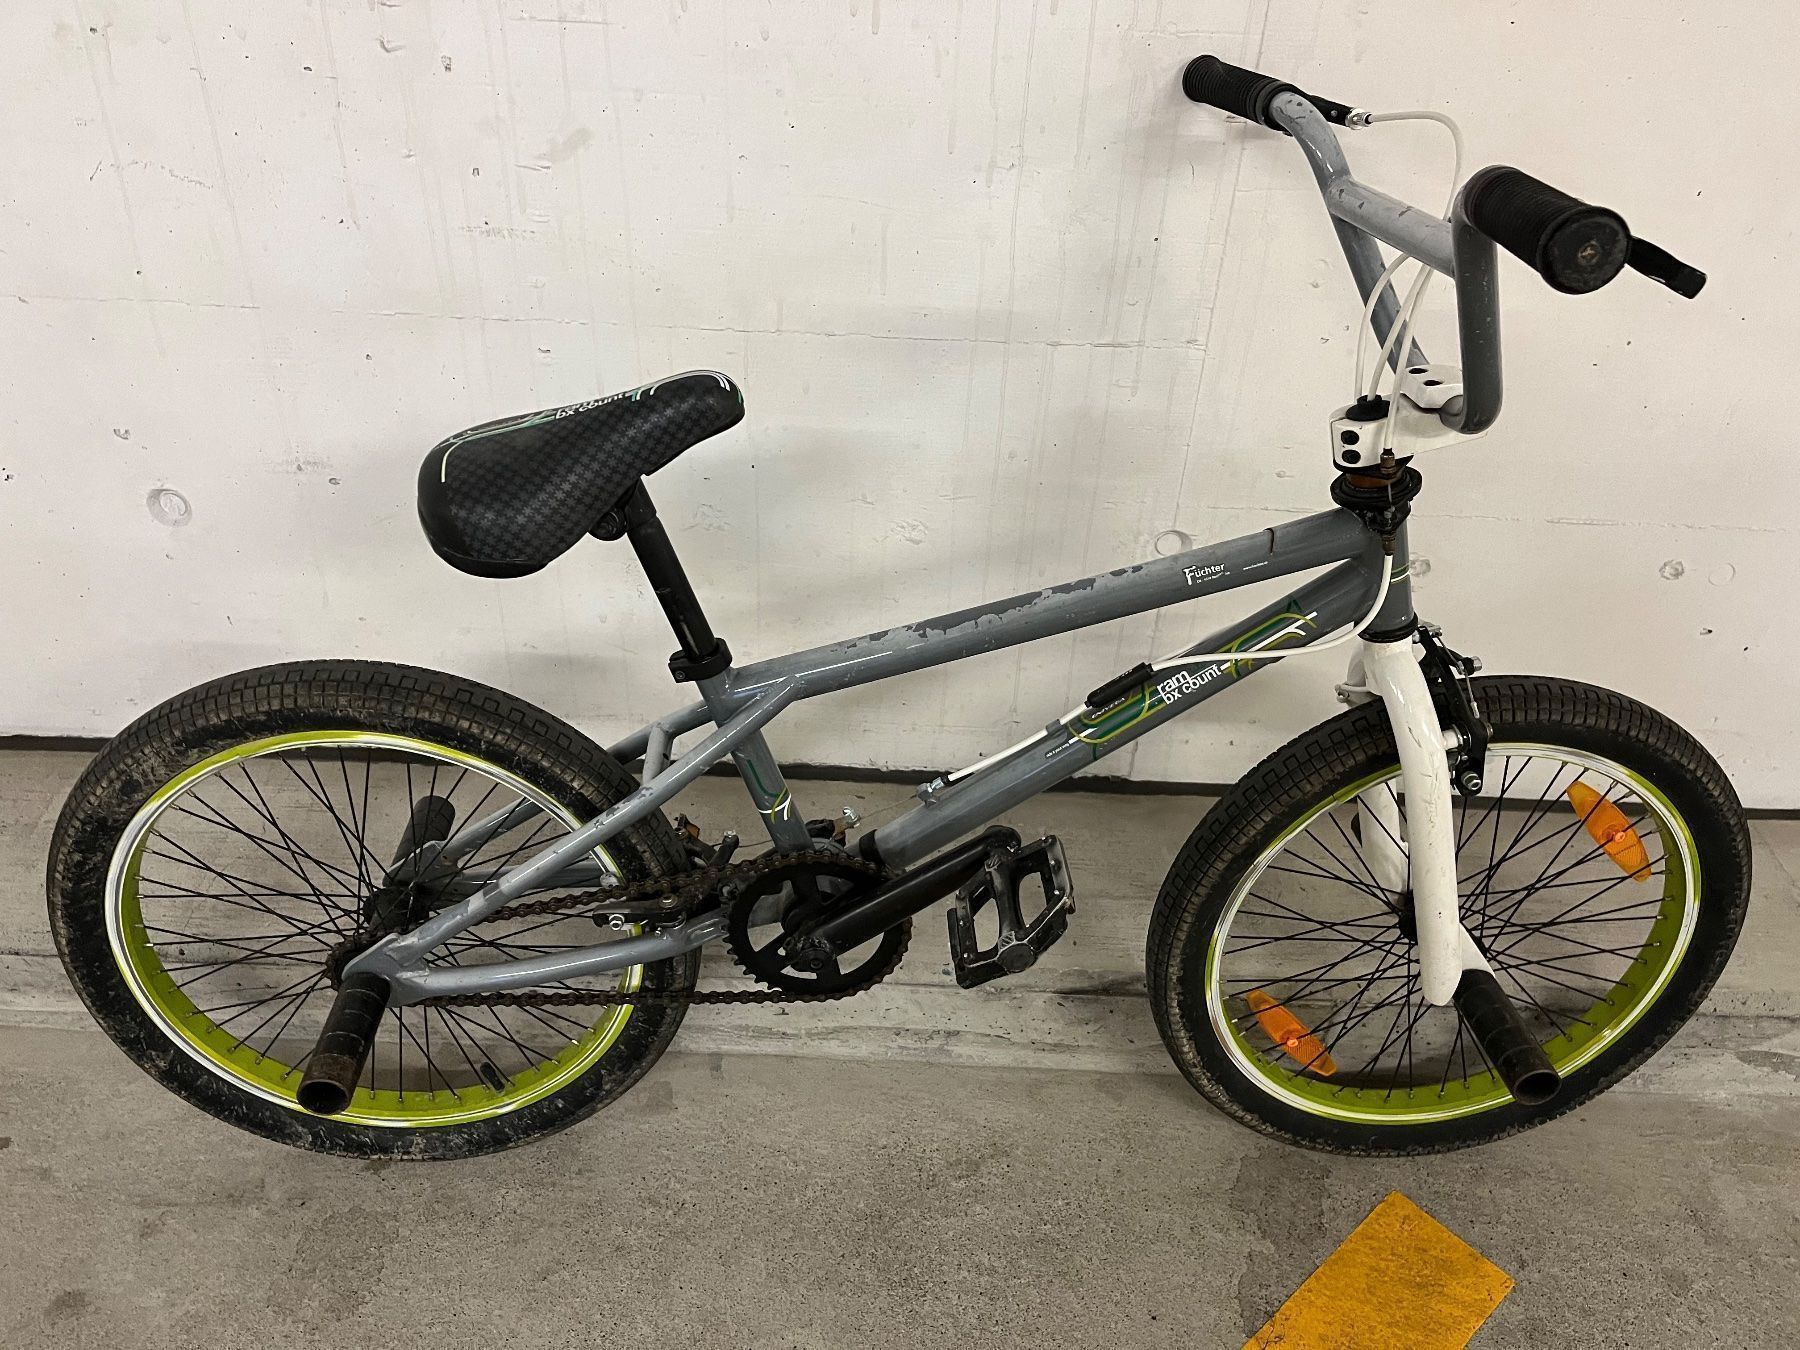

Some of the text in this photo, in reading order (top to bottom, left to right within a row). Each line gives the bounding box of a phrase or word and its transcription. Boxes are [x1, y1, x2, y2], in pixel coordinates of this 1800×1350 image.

[1182, 563, 1225, 586] Füchter
[1156, 670, 1190, 693] ram
[1181, 663, 1222, 693] count
